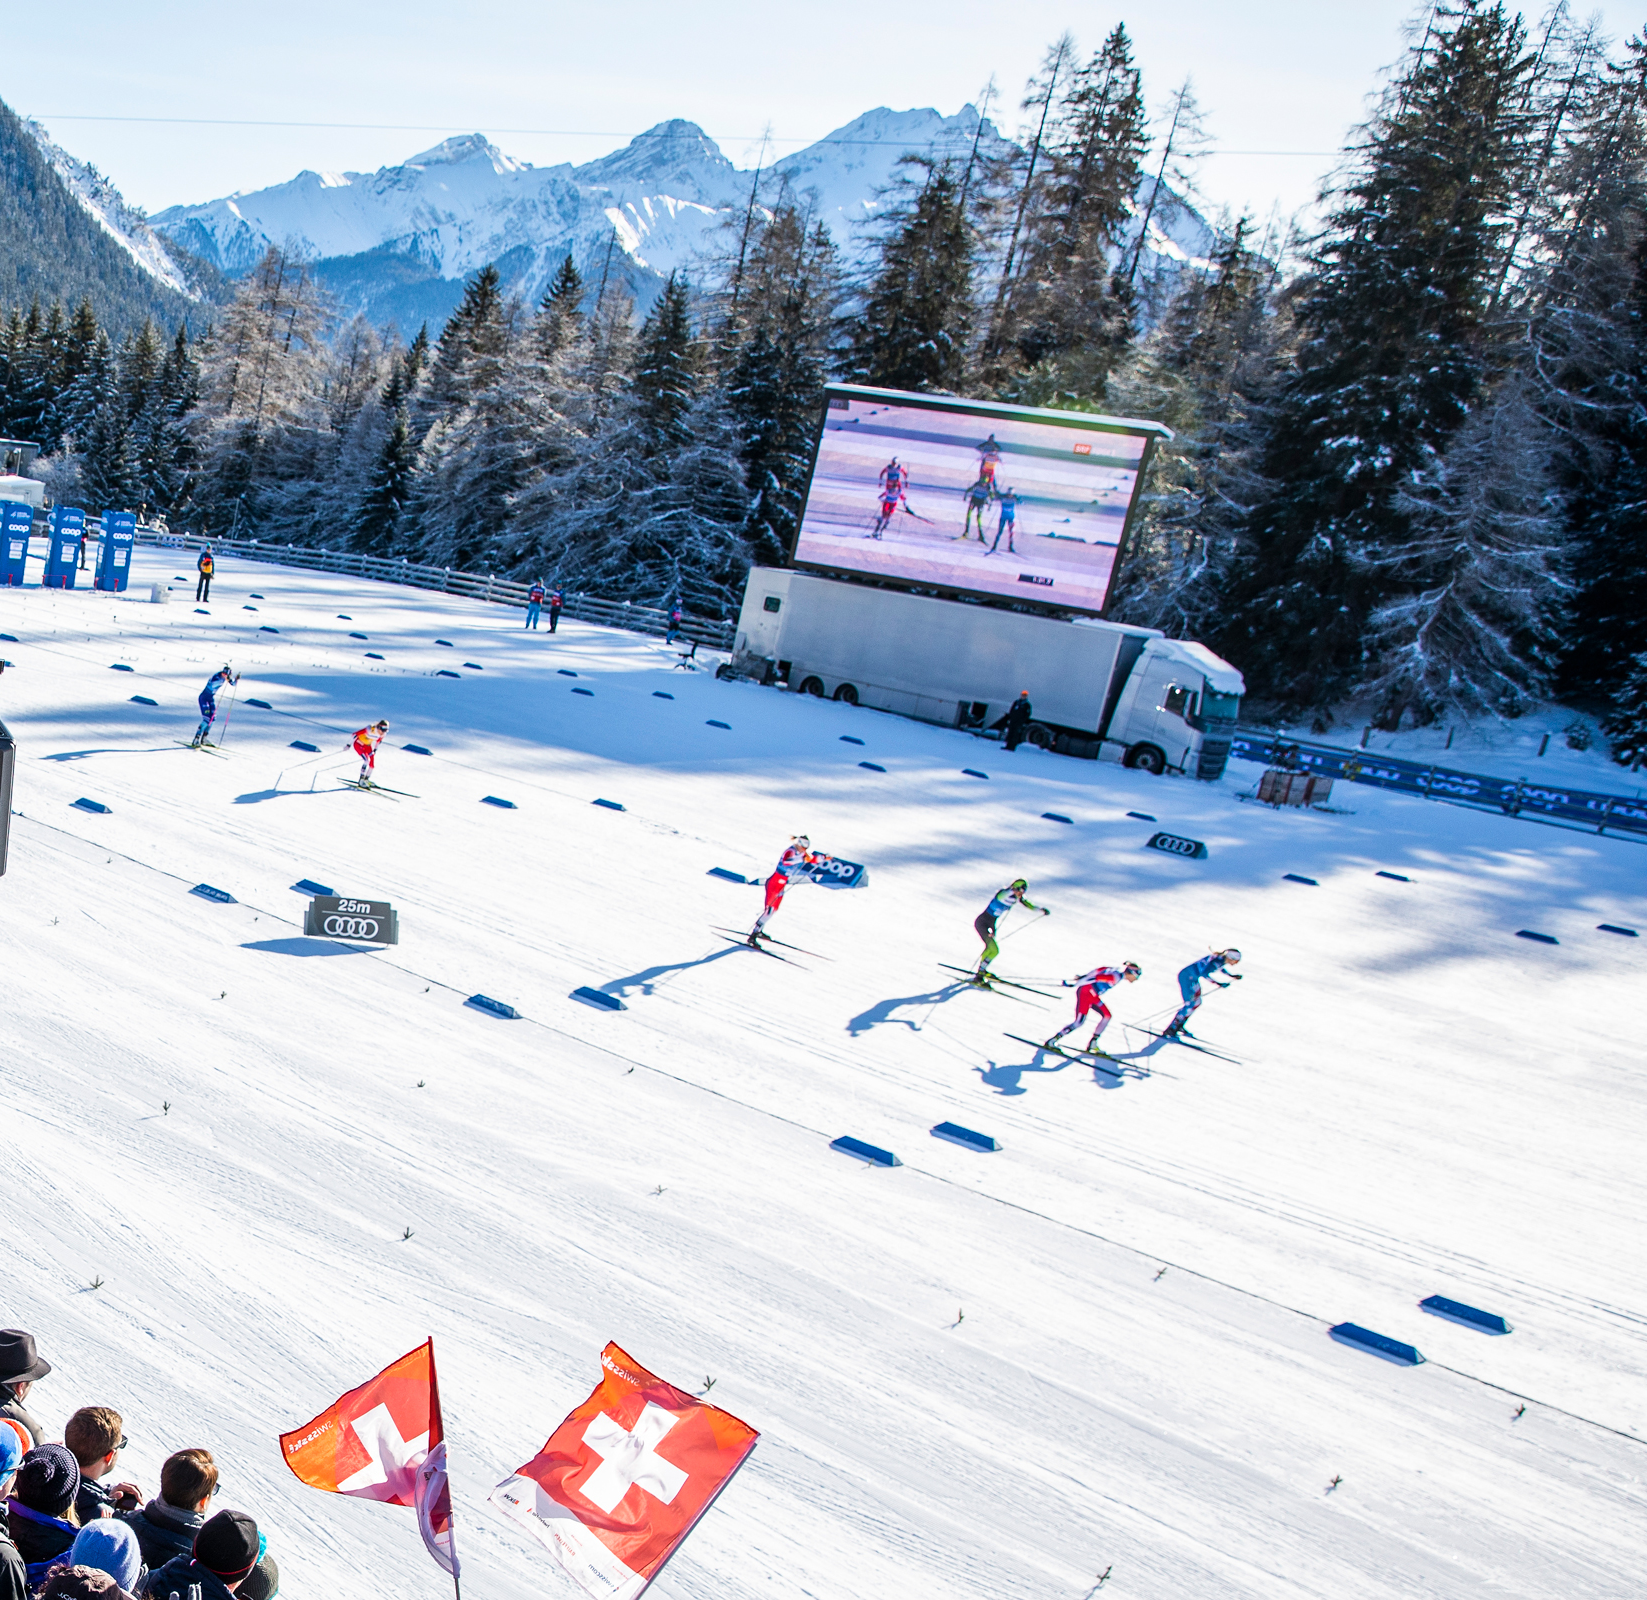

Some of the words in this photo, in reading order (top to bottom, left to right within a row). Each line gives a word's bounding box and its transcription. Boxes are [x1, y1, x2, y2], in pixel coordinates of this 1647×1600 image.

[8, 524, 30, 533] coop
[61, 527, 81, 537] coop
[112, 532, 133, 541] coop
[818, 859, 855, 878] oop
[338, 899, 371, 914] 25m
